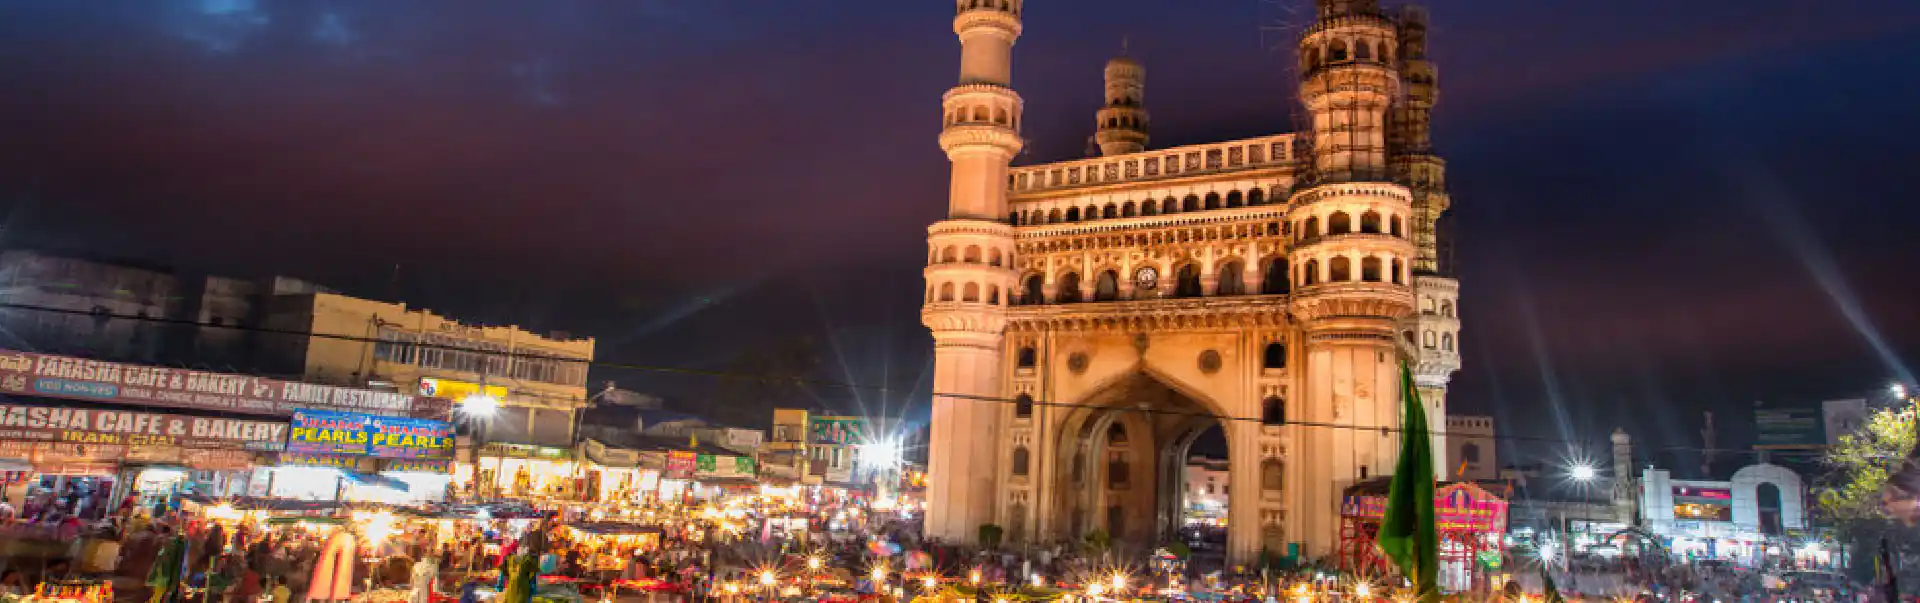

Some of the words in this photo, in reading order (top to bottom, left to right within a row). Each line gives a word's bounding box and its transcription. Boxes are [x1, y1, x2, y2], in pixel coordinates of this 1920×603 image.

[34, 355, 121, 384] FARASHA
[124, 366, 169, 388] CAFE
[169, 372, 183, 390] &
[187, 373, 247, 396] BAKERY
[283, 382, 332, 404] FAMILY
[334, 387, 414, 410] RESTAURANT
[96, 411, 162, 435] CAFE
[168, 418, 186, 436] &
[191, 417, 286, 441] BAKERY
[292, 427, 368, 444] PEARLS
[372, 433, 454, 449] PEARLS
